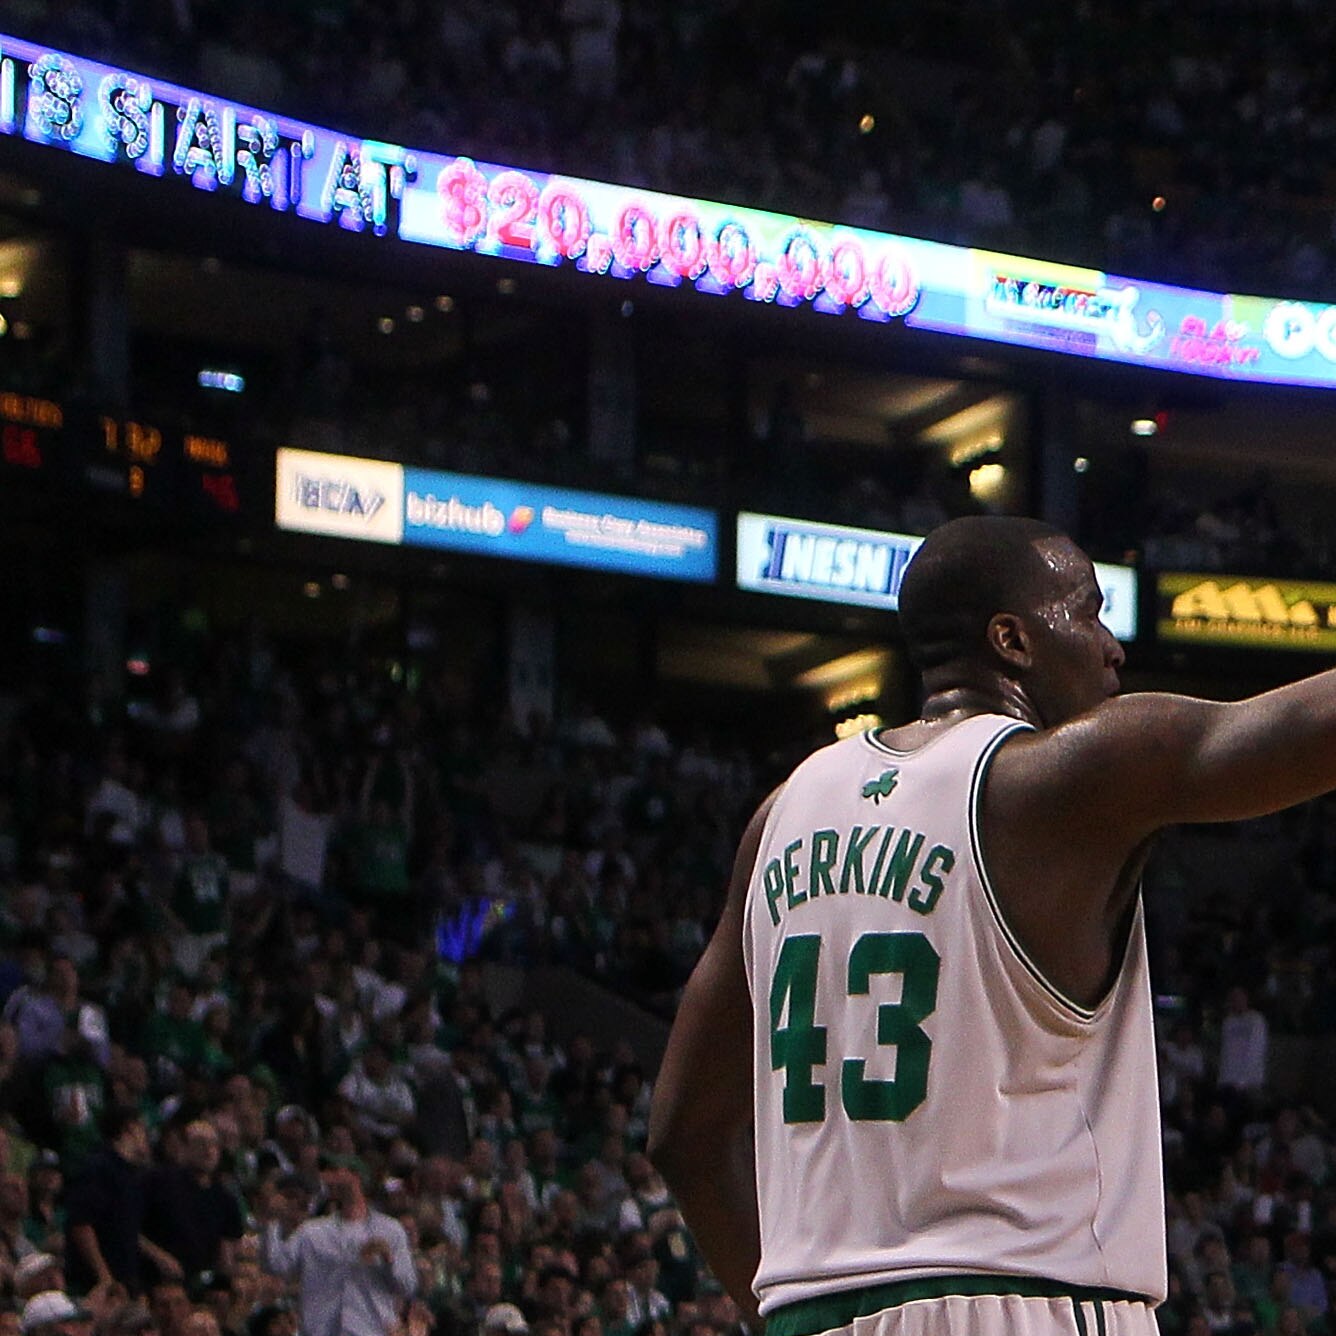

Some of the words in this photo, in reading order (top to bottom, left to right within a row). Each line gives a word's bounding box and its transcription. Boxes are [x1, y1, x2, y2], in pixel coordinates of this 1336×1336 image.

[437, 157, 918, 318] $20,000,000
[406, 490, 505, 537] bizhub
[785, 532, 890, 592] NESN
[763, 825, 955, 926] PERKINS
[769, 931, 941, 1124] 43
